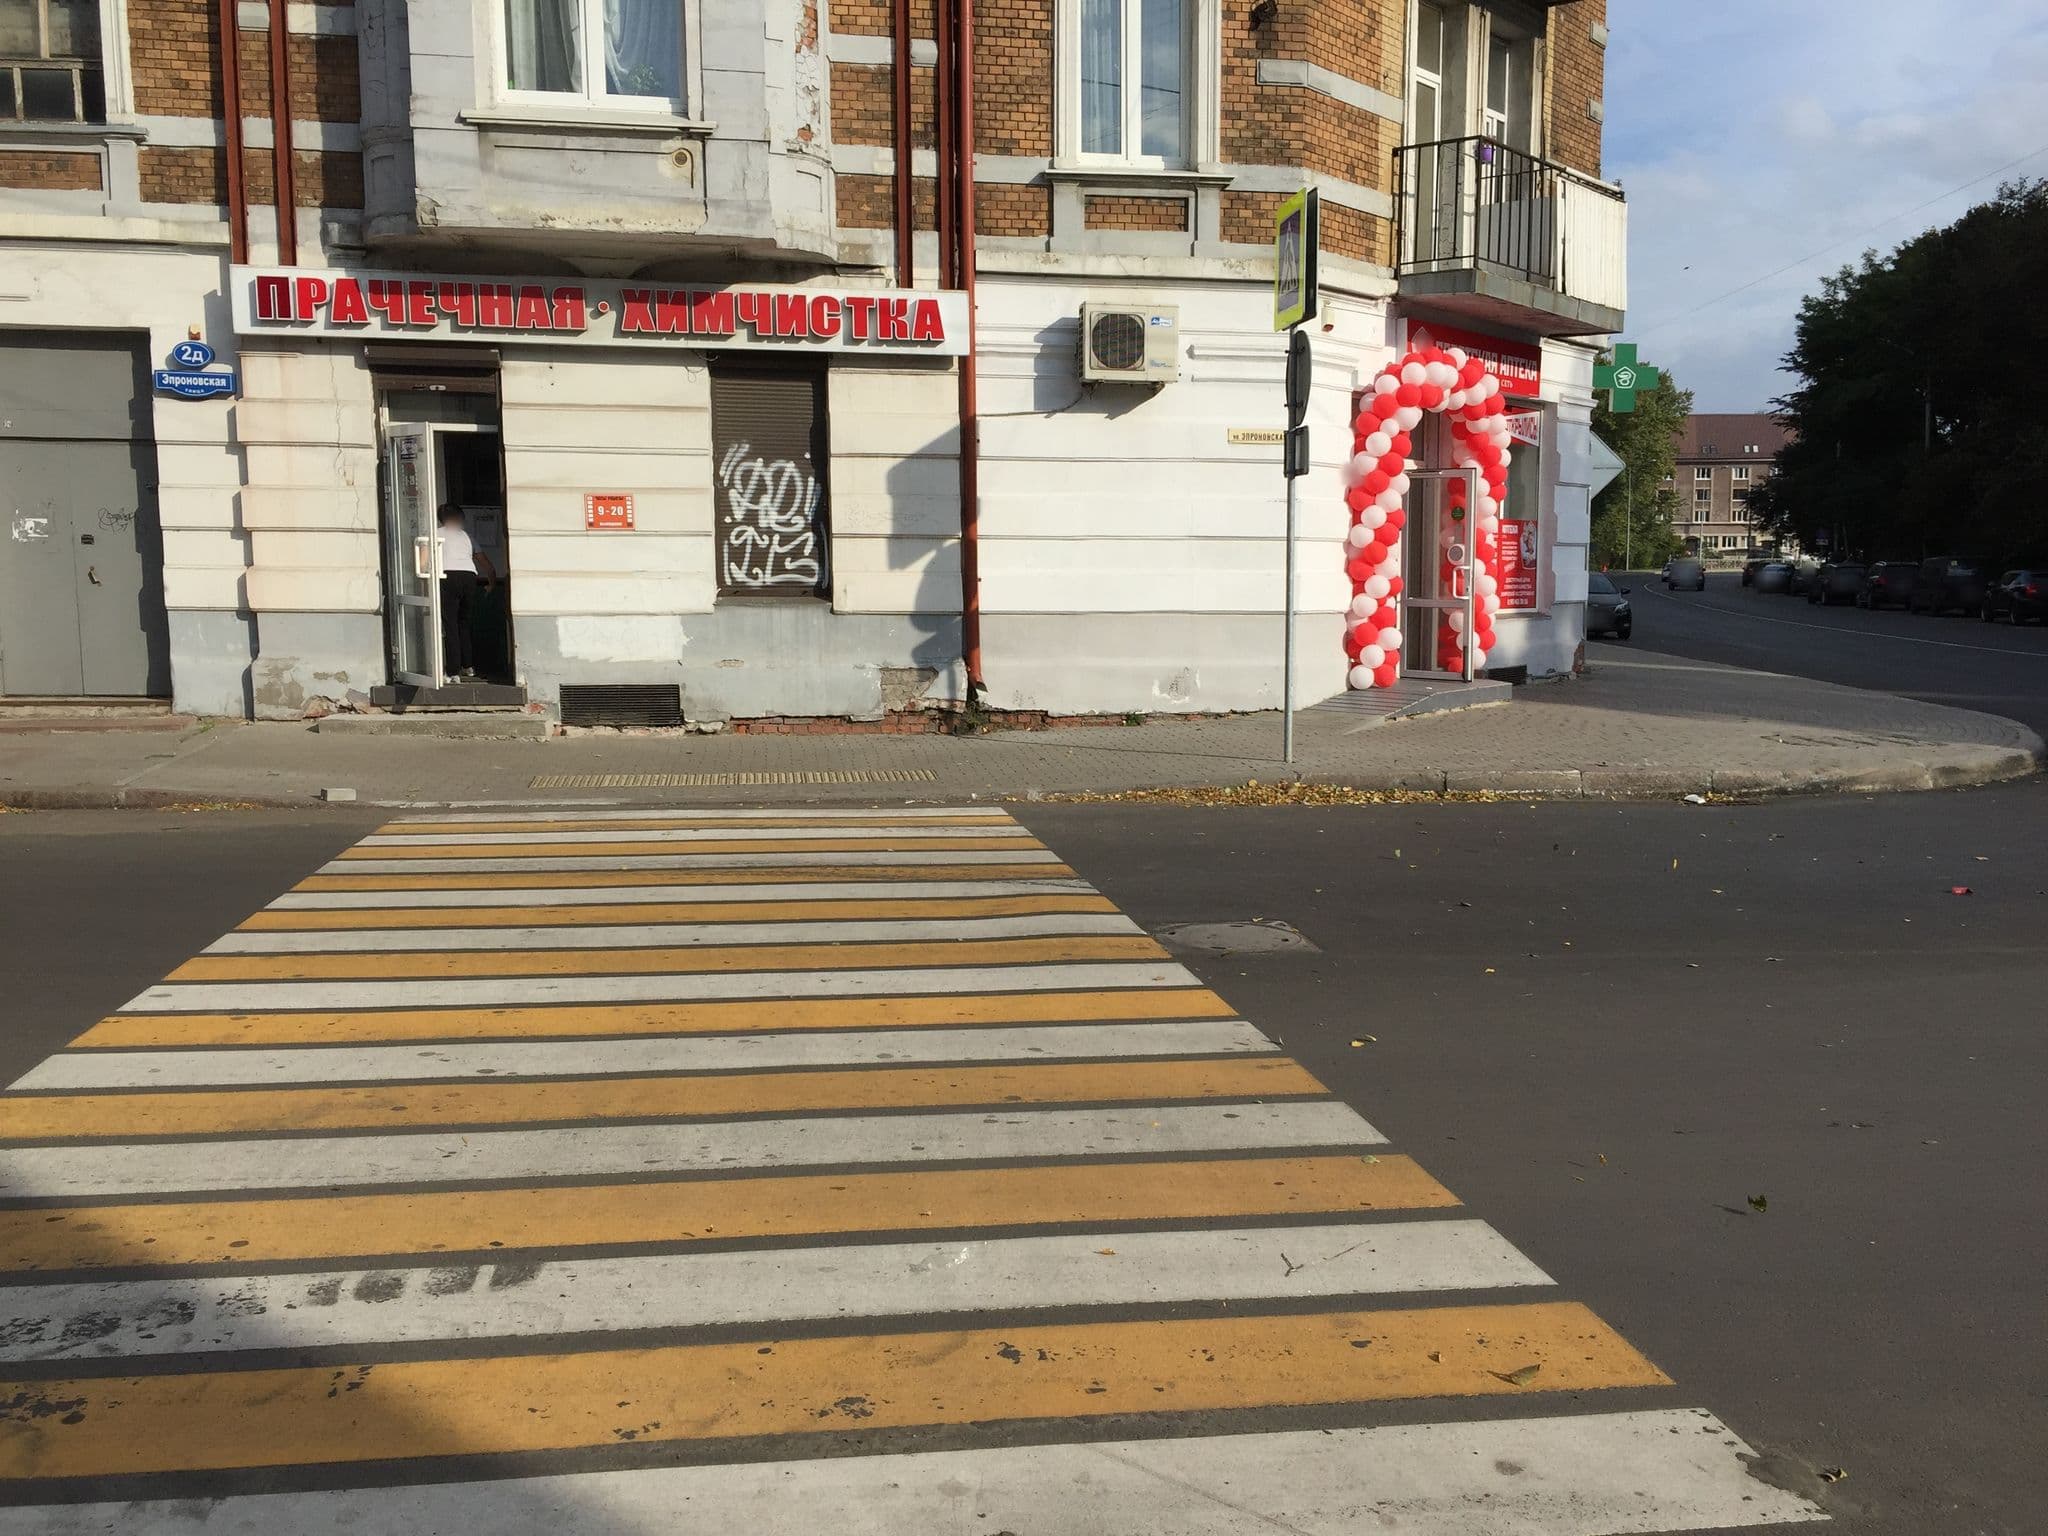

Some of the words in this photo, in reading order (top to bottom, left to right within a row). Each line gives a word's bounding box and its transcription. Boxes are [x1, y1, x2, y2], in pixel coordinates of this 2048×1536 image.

[255, 275, 588, 332] ПРАЧЕЧНАЯ
[619, 287, 946, 342] ХИМЧИСТКА
[161, 374, 227, 388] Эпроновская
[1500, 352, 1538, 382] АПТЕКА
